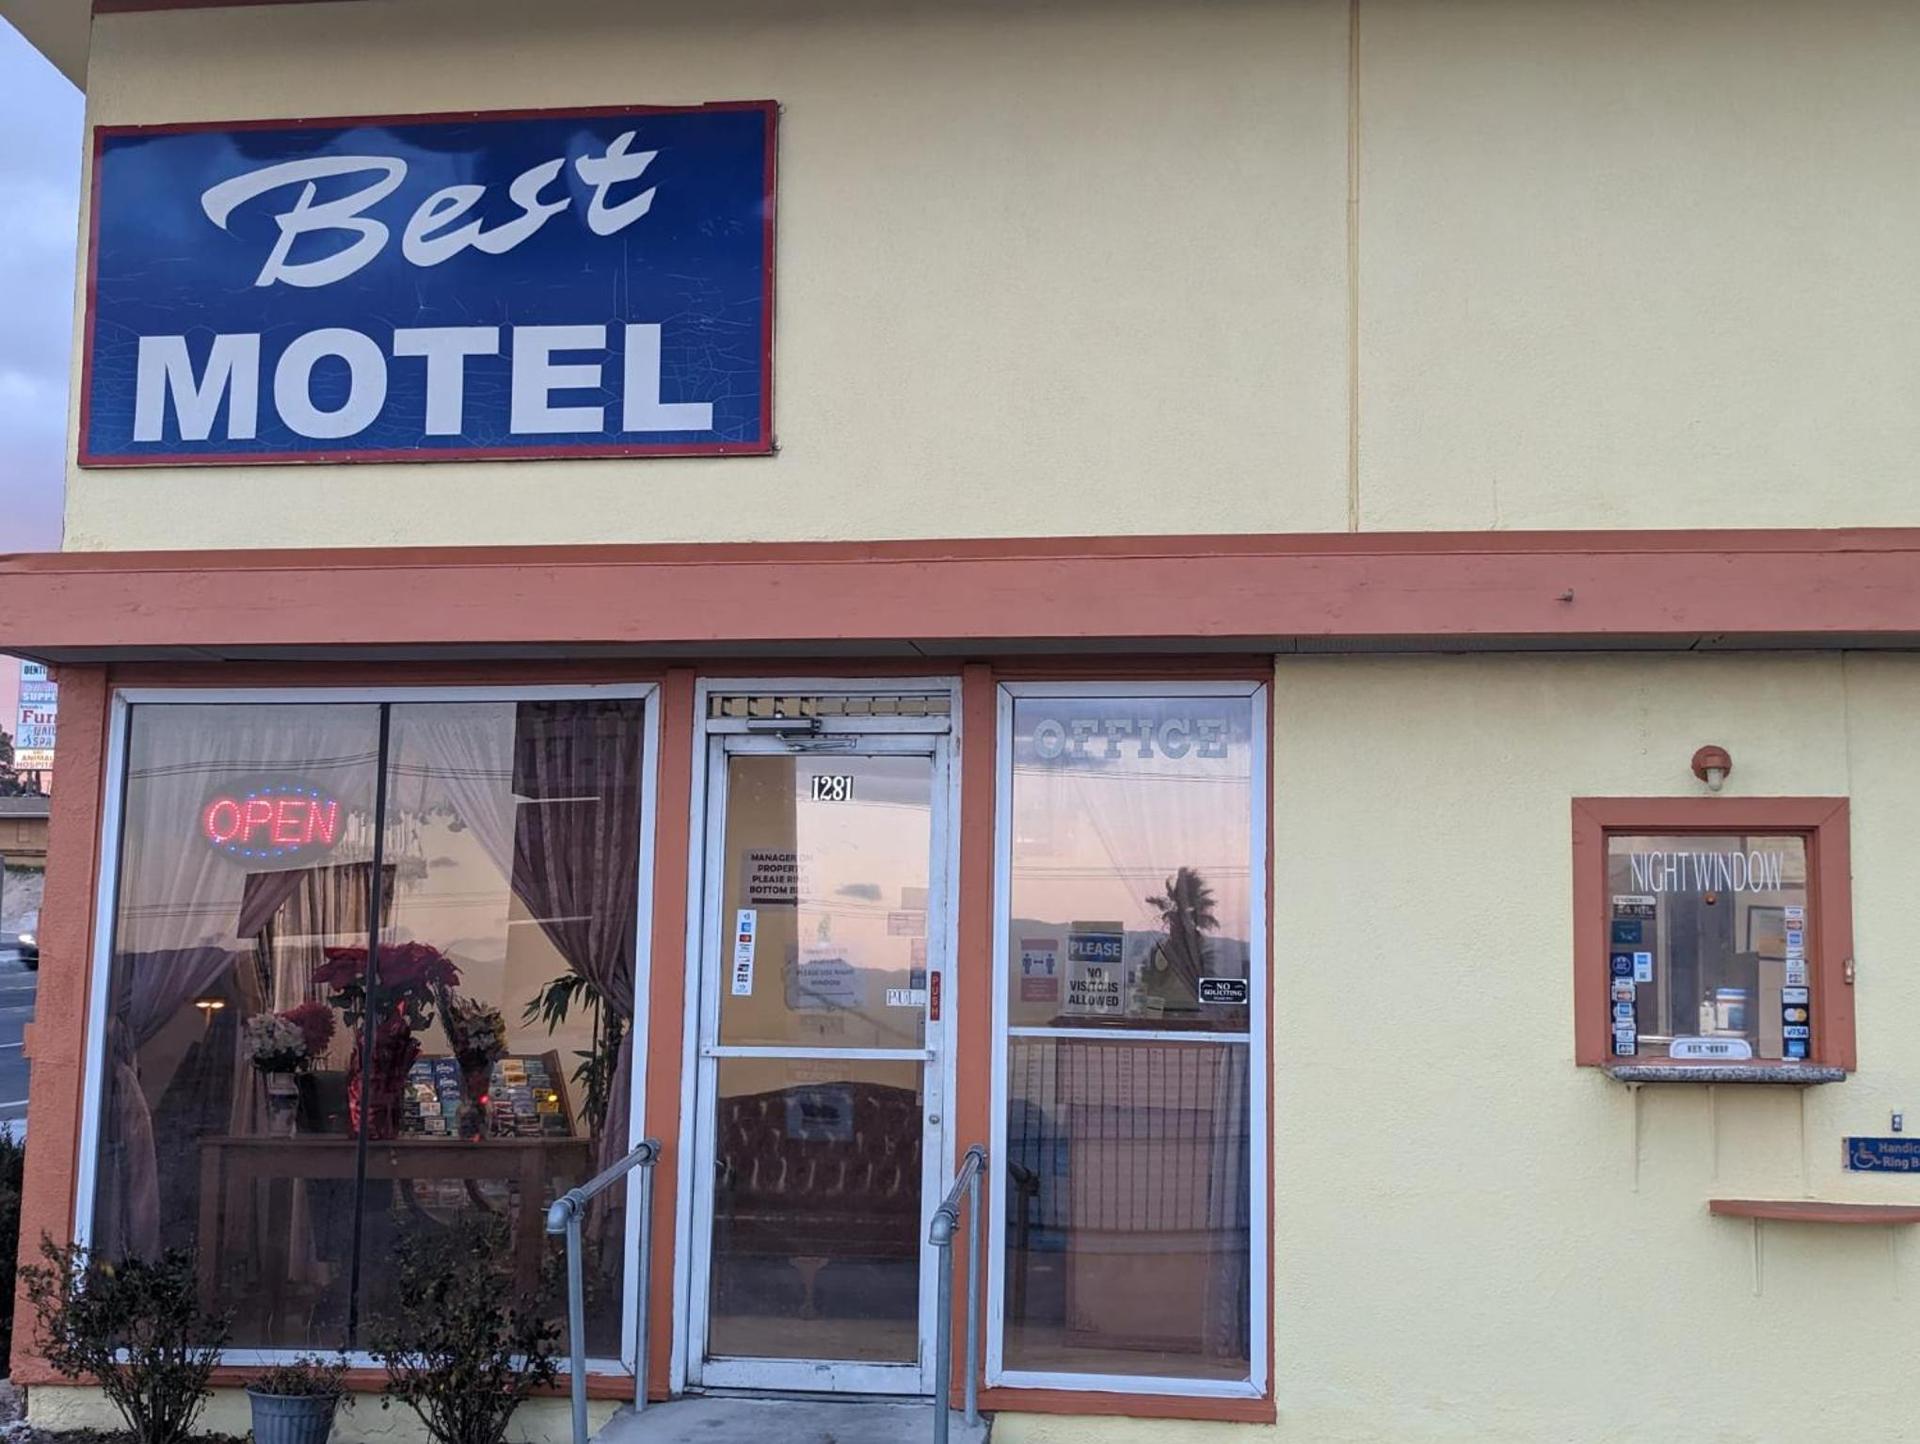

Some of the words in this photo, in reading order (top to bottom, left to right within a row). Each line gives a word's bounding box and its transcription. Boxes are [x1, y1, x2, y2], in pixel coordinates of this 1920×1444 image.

[201, 131, 658, 288] Best
[133, 323, 714, 442] MOTEL
[22, 709, 58, 724] Fur
[1033, 718, 1229, 760] OFFICE
[812, 775, 853, 801] 1281
[208, 800, 337, 843] OPEN
[1630, 851, 1689, 893] NIGHT
[1693, 851, 1784, 893] WINDOW
[749, 886, 787, 894] BOTTOM
[1068, 941, 1121, 956] PLEASE
[1087, 967, 1102, 978] NO
[1216, 982, 1231, 990] NO
[1068, 994, 1120, 1007] ALLOWED
[1882, 1156, 1908, 1170] Ring
